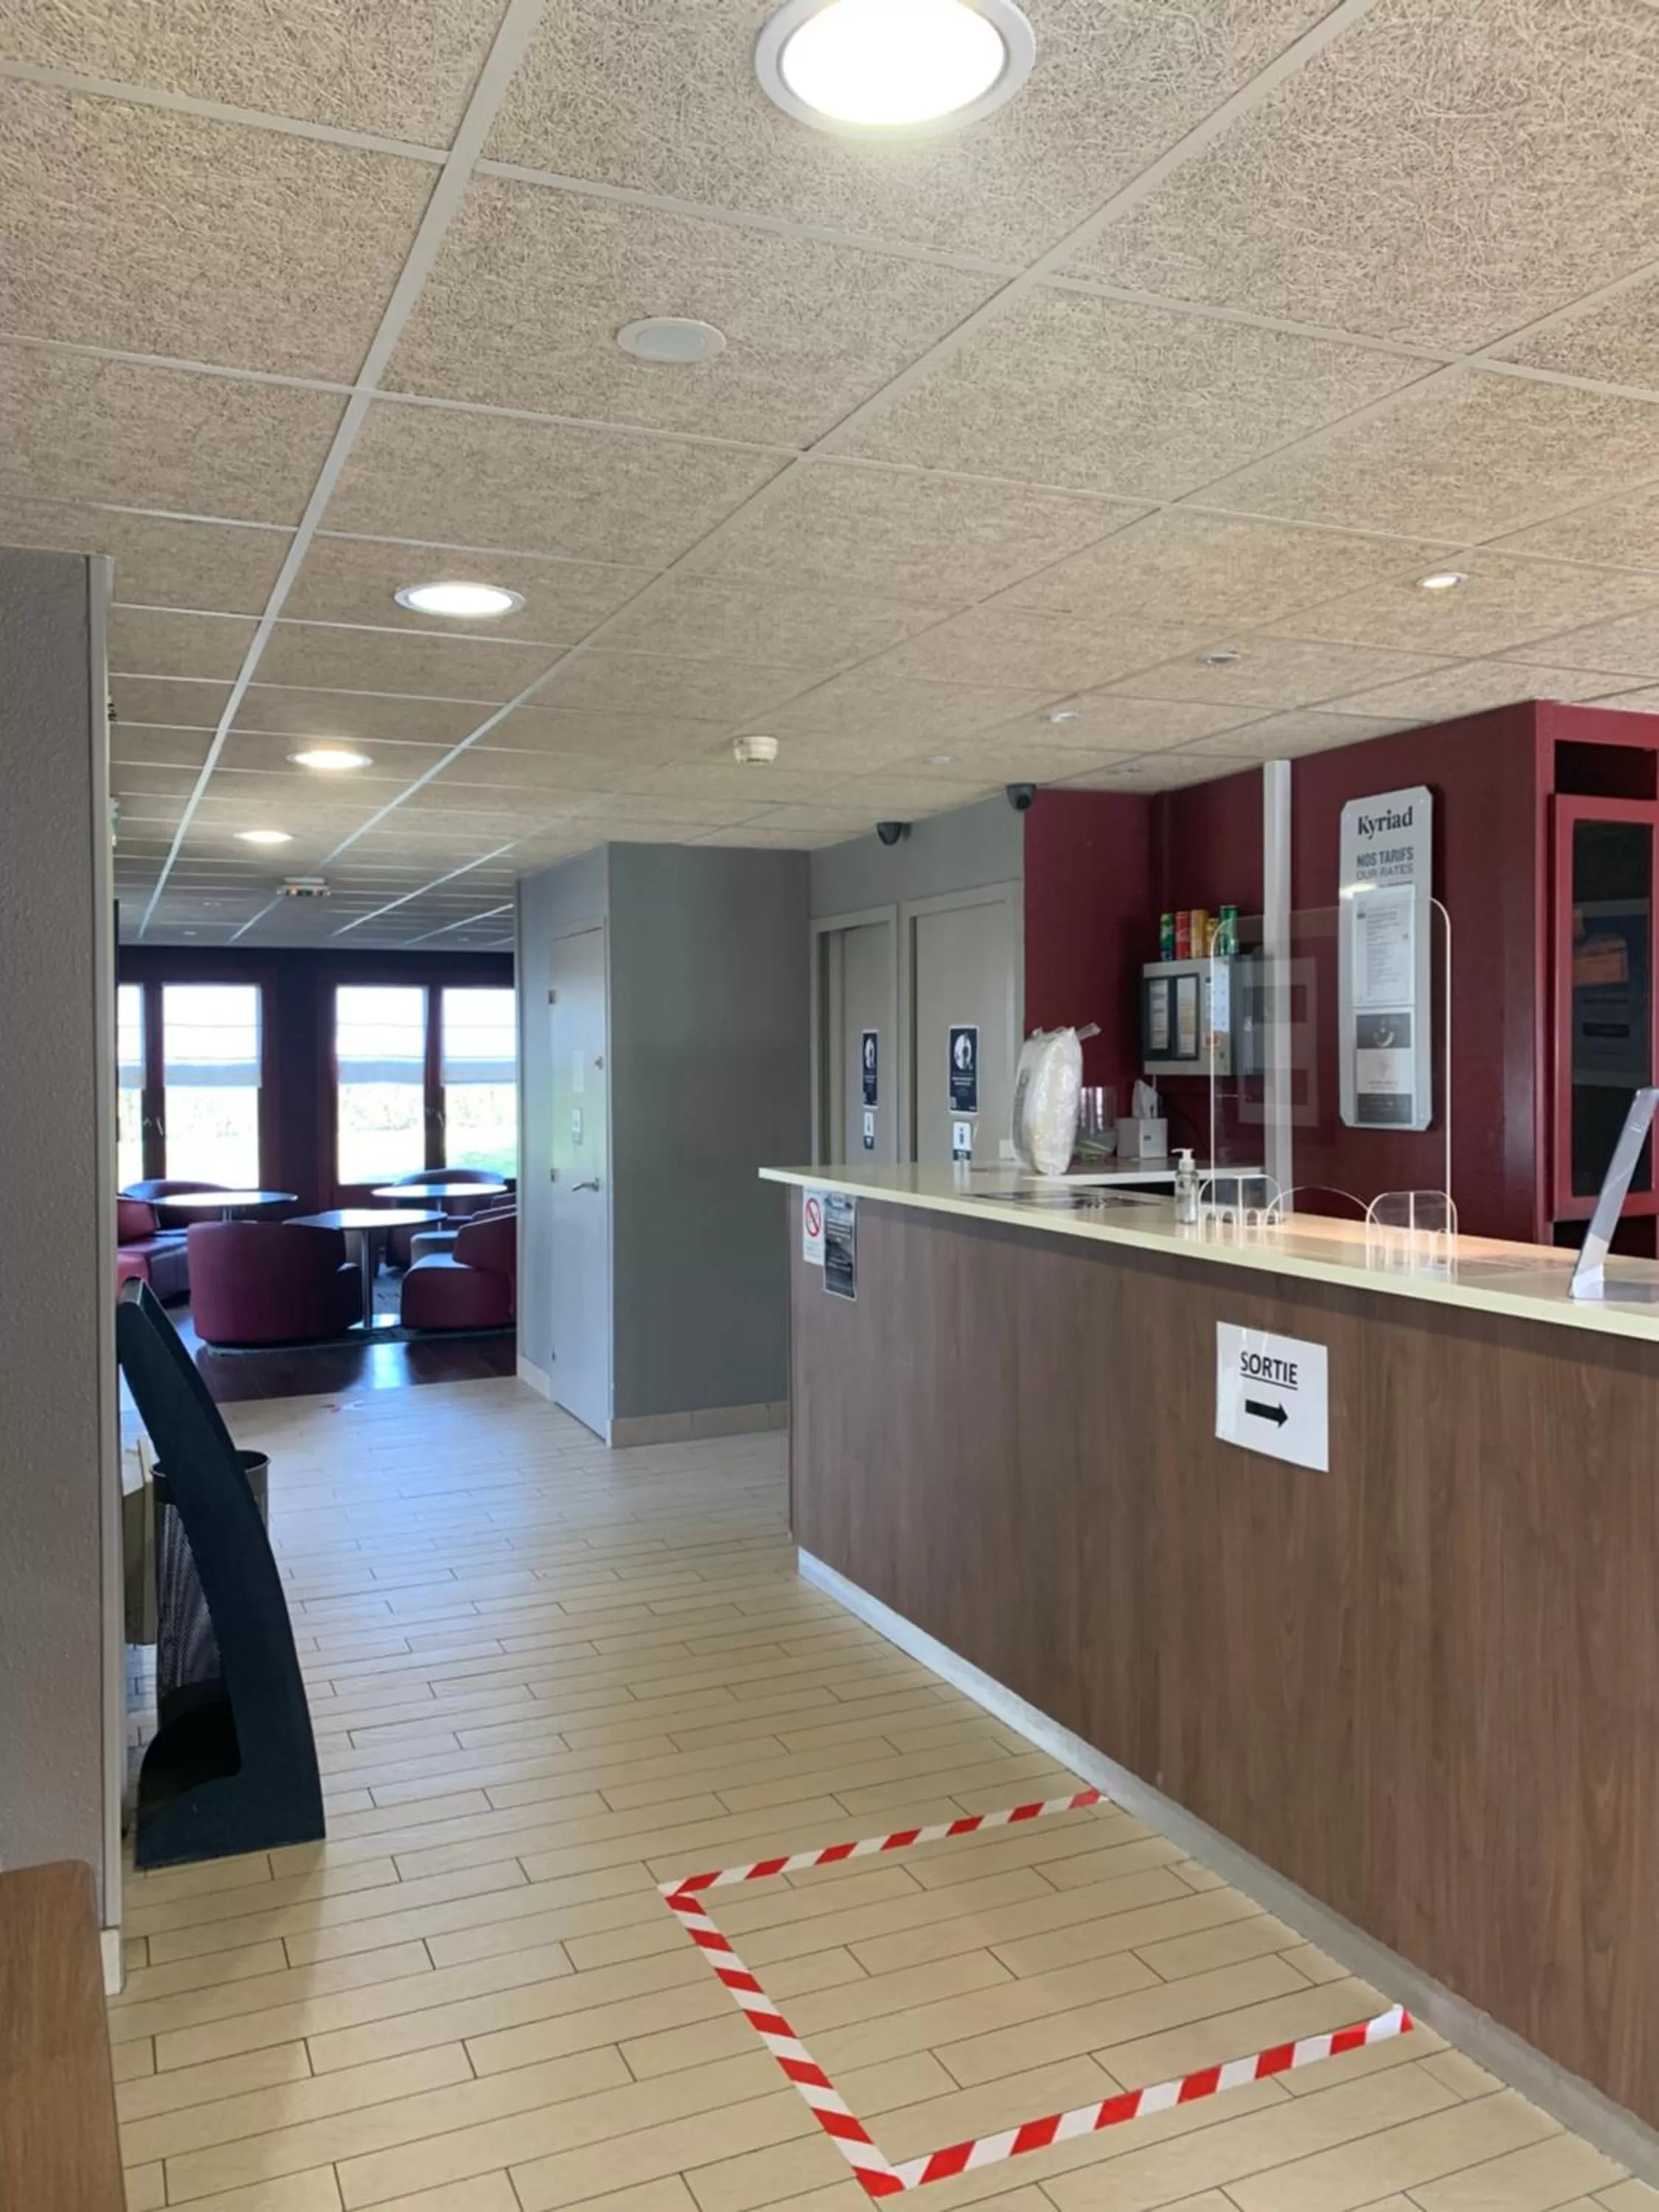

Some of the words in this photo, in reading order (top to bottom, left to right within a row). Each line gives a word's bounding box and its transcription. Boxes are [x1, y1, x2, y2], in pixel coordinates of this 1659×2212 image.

[1357, 805, 1413, 840] Kyriad
[1357, 852, 1377, 867] NOS
[1379, 846, 1414, 864] TARIFS
[1356, 869, 1377, 880] OUR
[1380, 863, 1414, 877] RATES
[1240, 1351, 1298, 1385] SORTIE
